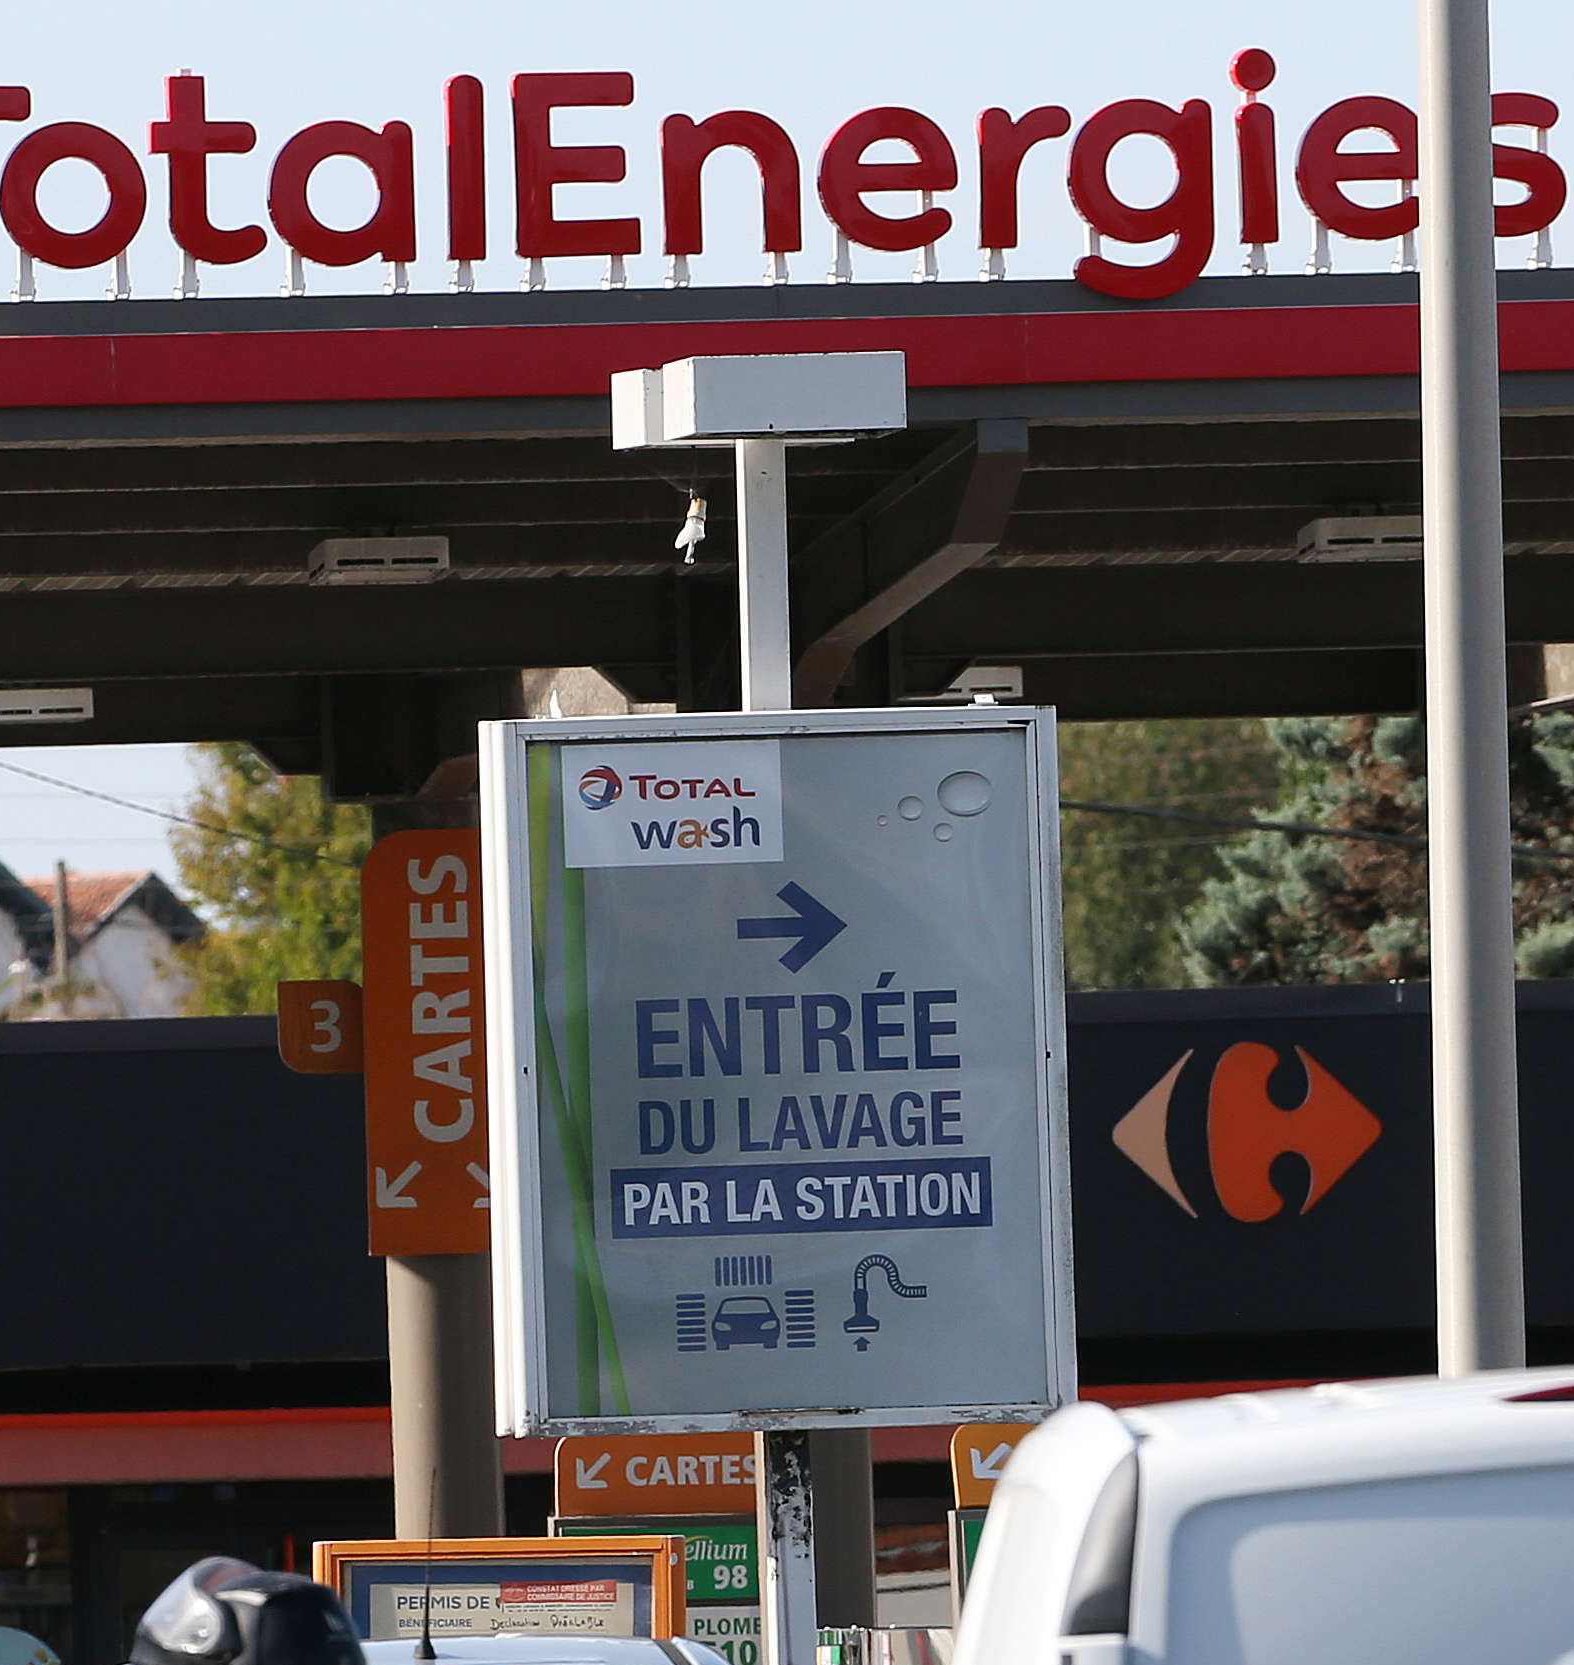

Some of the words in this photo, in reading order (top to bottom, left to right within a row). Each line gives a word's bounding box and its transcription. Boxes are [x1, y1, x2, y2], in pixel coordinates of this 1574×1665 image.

[629, 774, 756, 800] TOTAL
[630, 805, 760, 850] wash
[407, 853, 475, 1143] CARTES
[310, 999, 343, 1054] 3
[635, 971, 962, 1079] ENTRÉE
[638, 1098, 716, 1156] DU
[739, 1090, 964, 1153] LAVAGE
[623, 1179, 712, 1227] PAR
[725, 1177, 783, 1223] LA
[795, 1170, 982, 1221] STATION
[685, 1540, 747, 1561] ellium
[590, 1584, 605, 1592] PAR
[713, 1565, 748, 1590] 98
[398, 1596, 461, 1609] PERMIS
[467, 1596, 490, 1609] DE
[587, 1592, 615, 1601] JUSTICE
